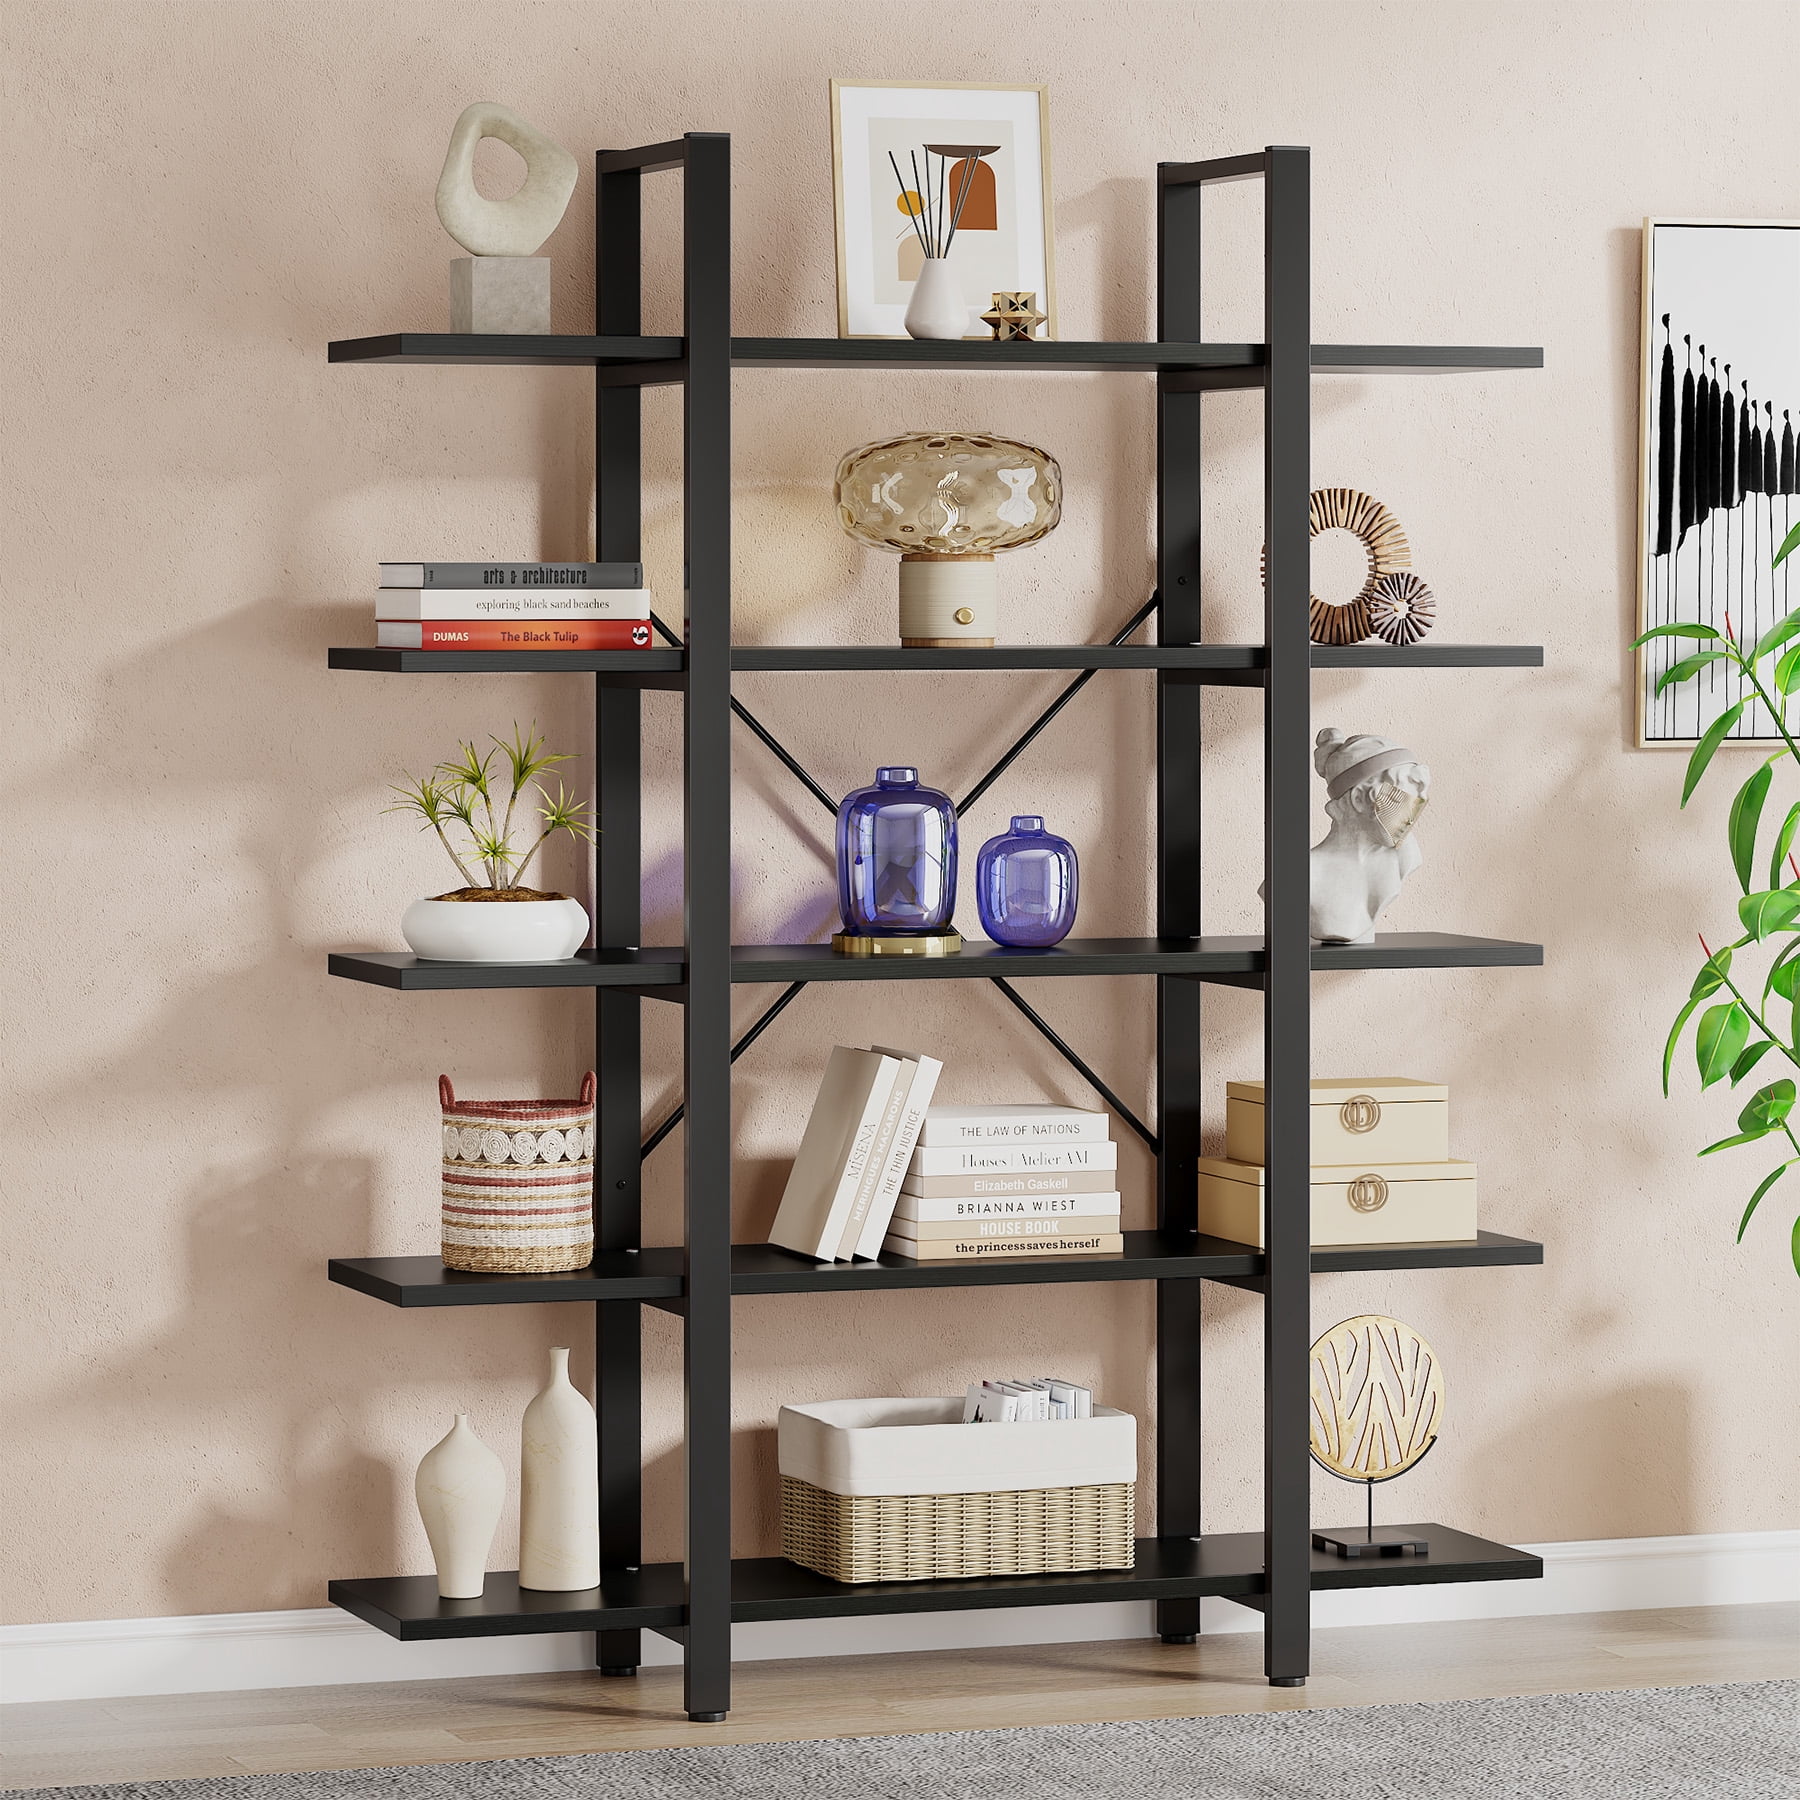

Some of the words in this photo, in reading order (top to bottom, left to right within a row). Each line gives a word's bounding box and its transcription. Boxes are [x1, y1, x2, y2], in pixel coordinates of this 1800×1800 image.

[483, 567, 505, 585] arts
[510, 569, 518, 585] &
[522, 566, 588, 585] architecture
[476, 599, 521, 612] exploring
[523, 599, 548, 609] black
[550, 599, 572, 609] sand
[573, 598, 610, 609] beaches
[433, 632, 469, 642] DUMAS
[500, 631, 521, 642] The
[523, 631, 551, 642] Black
[553, 631, 579, 643] Tulip
[960, 1126, 982, 1137] THE
[987, 1126, 1010, 1137] LAW
[1013, 1125, 1028, 1136] OF
[1032, 1124, 1081, 1135] NATIONS
[853, 1156, 881, 1221] MERINGUES
[877, 1090, 904, 1153] MACARONS
[882, 1175, 898, 1195] THE
[890, 1150, 906, 1175] THIN
[900, 1108, 921, 1149] JUSTICE
[962, 1153, 1007, 1168] Houses
[974, 1179, 1025, 1192] Elizabeth
[1027, 1177, 1069, 1190] Gaskell
[957, 1202, 1025, 1214] BRIANNA
[1032, 1200, 1076, 1212] WIEST
[980, 1221, 1021, 1236] HOUSE
[1025, 1220, 1060, 1234] BOOK
